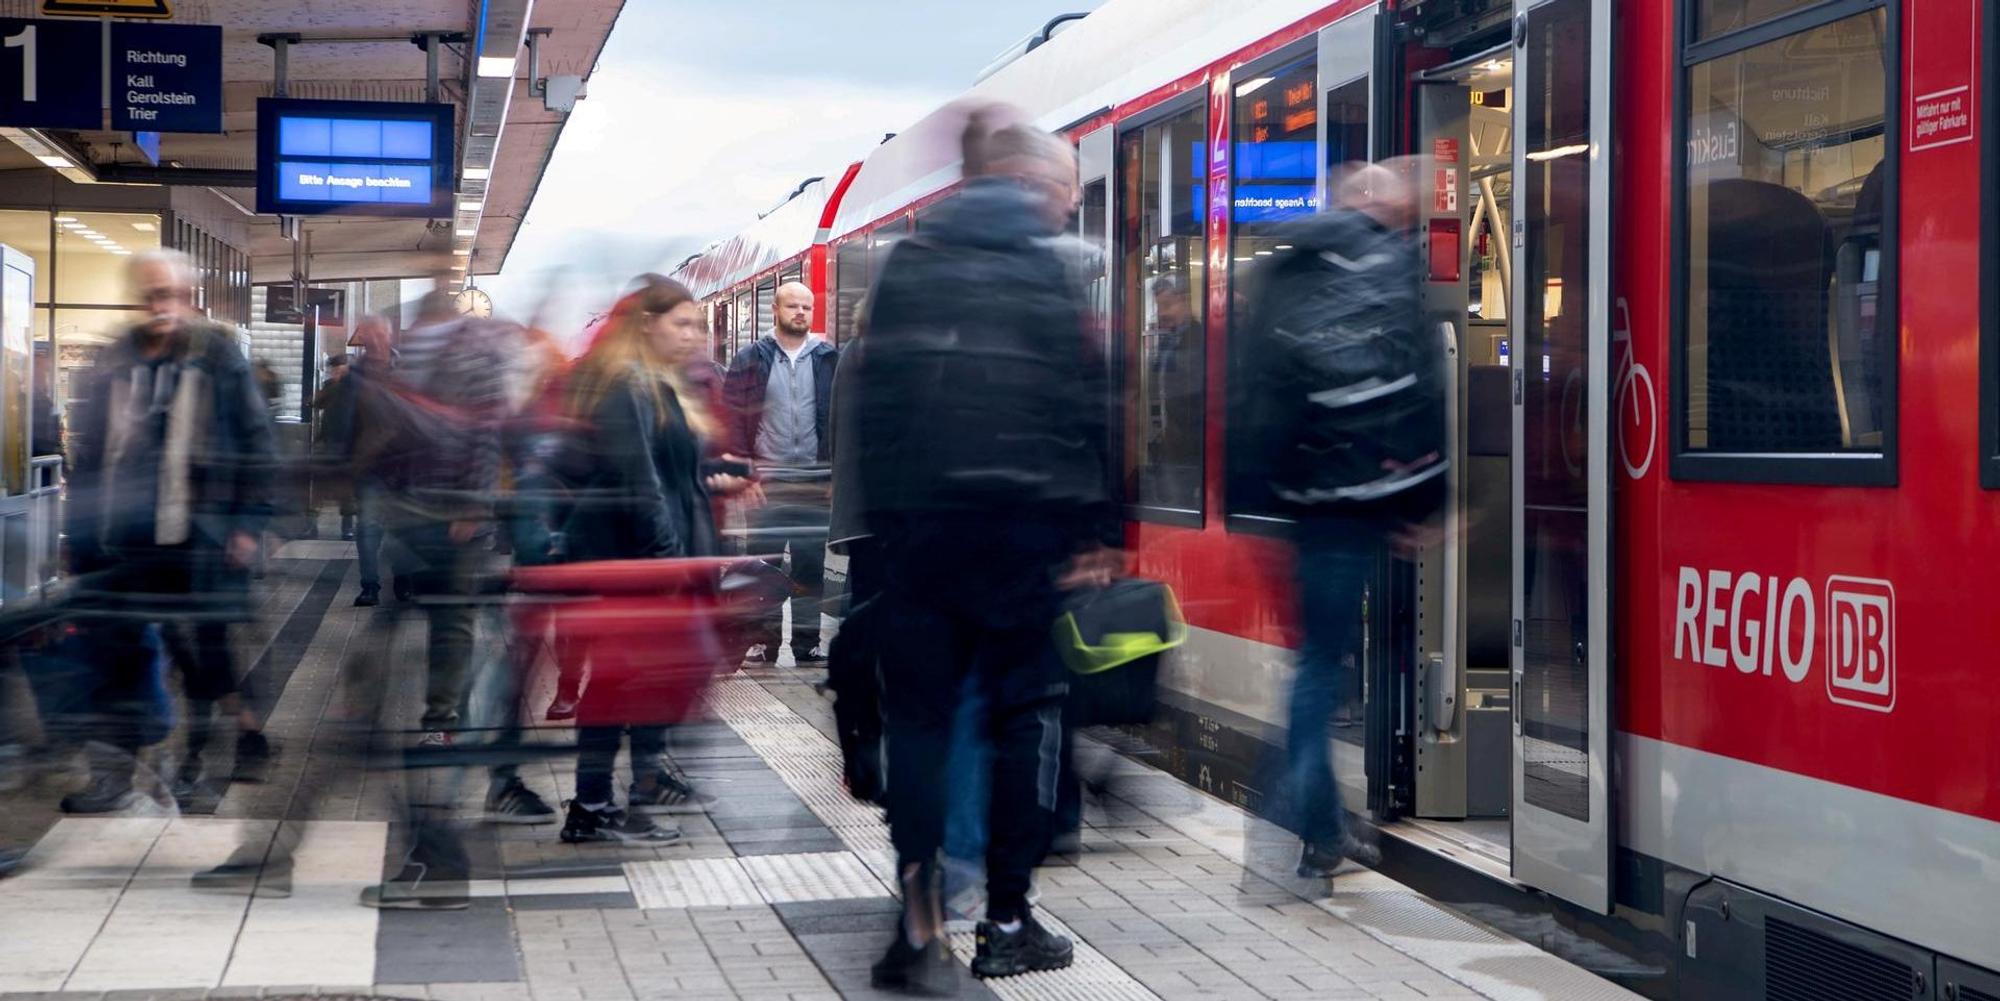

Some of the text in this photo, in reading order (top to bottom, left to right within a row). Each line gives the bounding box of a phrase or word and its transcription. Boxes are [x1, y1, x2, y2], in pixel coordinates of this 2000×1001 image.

[4, 25, 37, 102] 1
[126, 50, 187, 67] Richtung
[126, 74, 155, 88] Kall
[126, 90, 196, 105] Gerolstein
[126, 106, 158, 120] Trier
[1917, 97, 1961, 120] Mitfahrt nur mit
[1213, 93, 1226, 163] 2
[1916, 113, 1967, 139] gültiger Fahrkarte
[299, 174, 411, 188] Bitte Ansage beachten
[1674, 566, 1888, 692] REGIO DB
